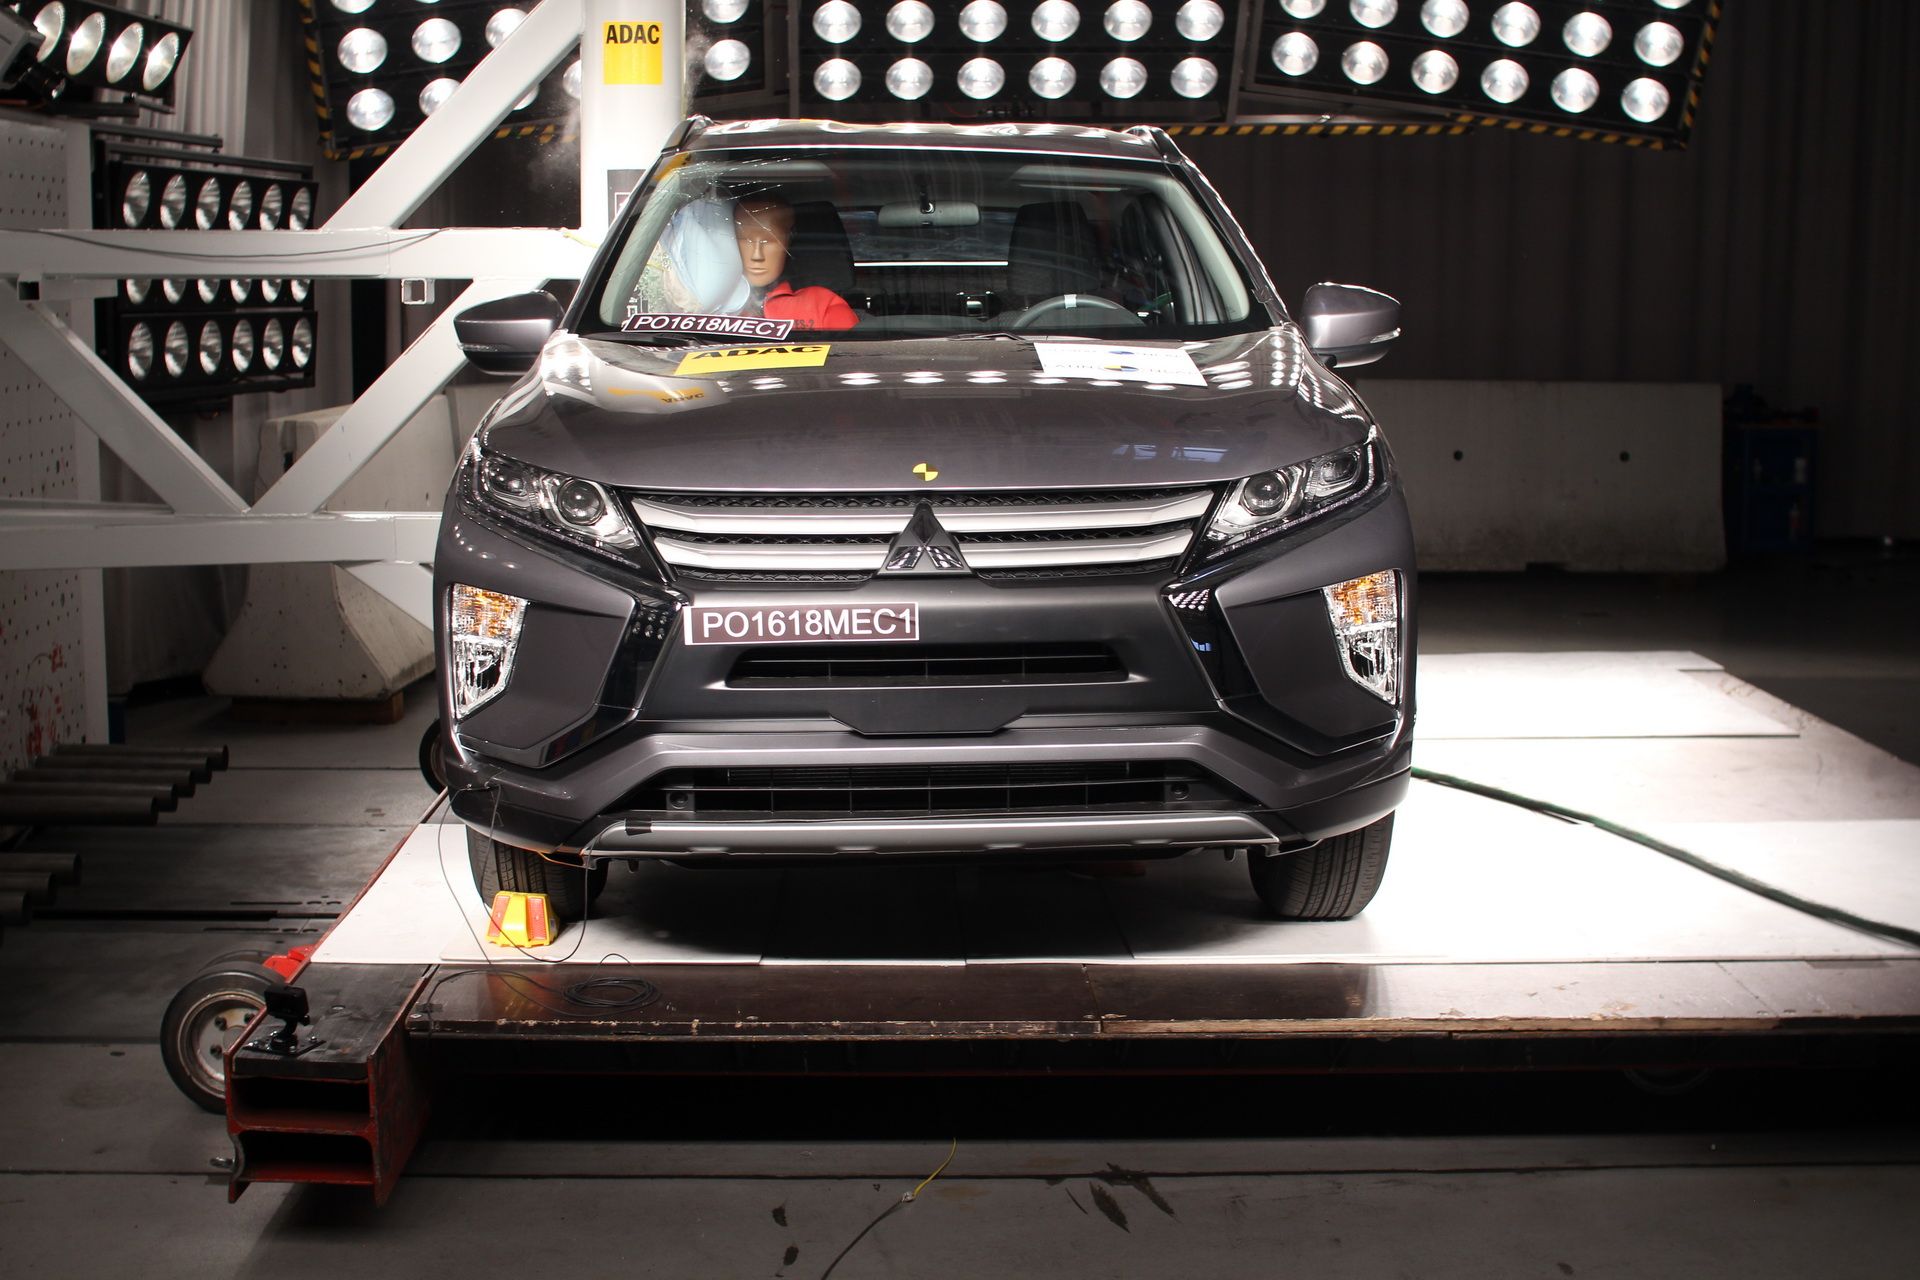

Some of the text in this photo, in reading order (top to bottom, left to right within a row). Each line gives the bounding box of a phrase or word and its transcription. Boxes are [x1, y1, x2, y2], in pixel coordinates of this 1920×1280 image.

[606, 24, 660, 44] ADAC
[634, 316, 787, 337] PO1618MEC1
[692, 346, 823, 360] ADAC
[703, 608, 911, 638] PO1618MEC1
